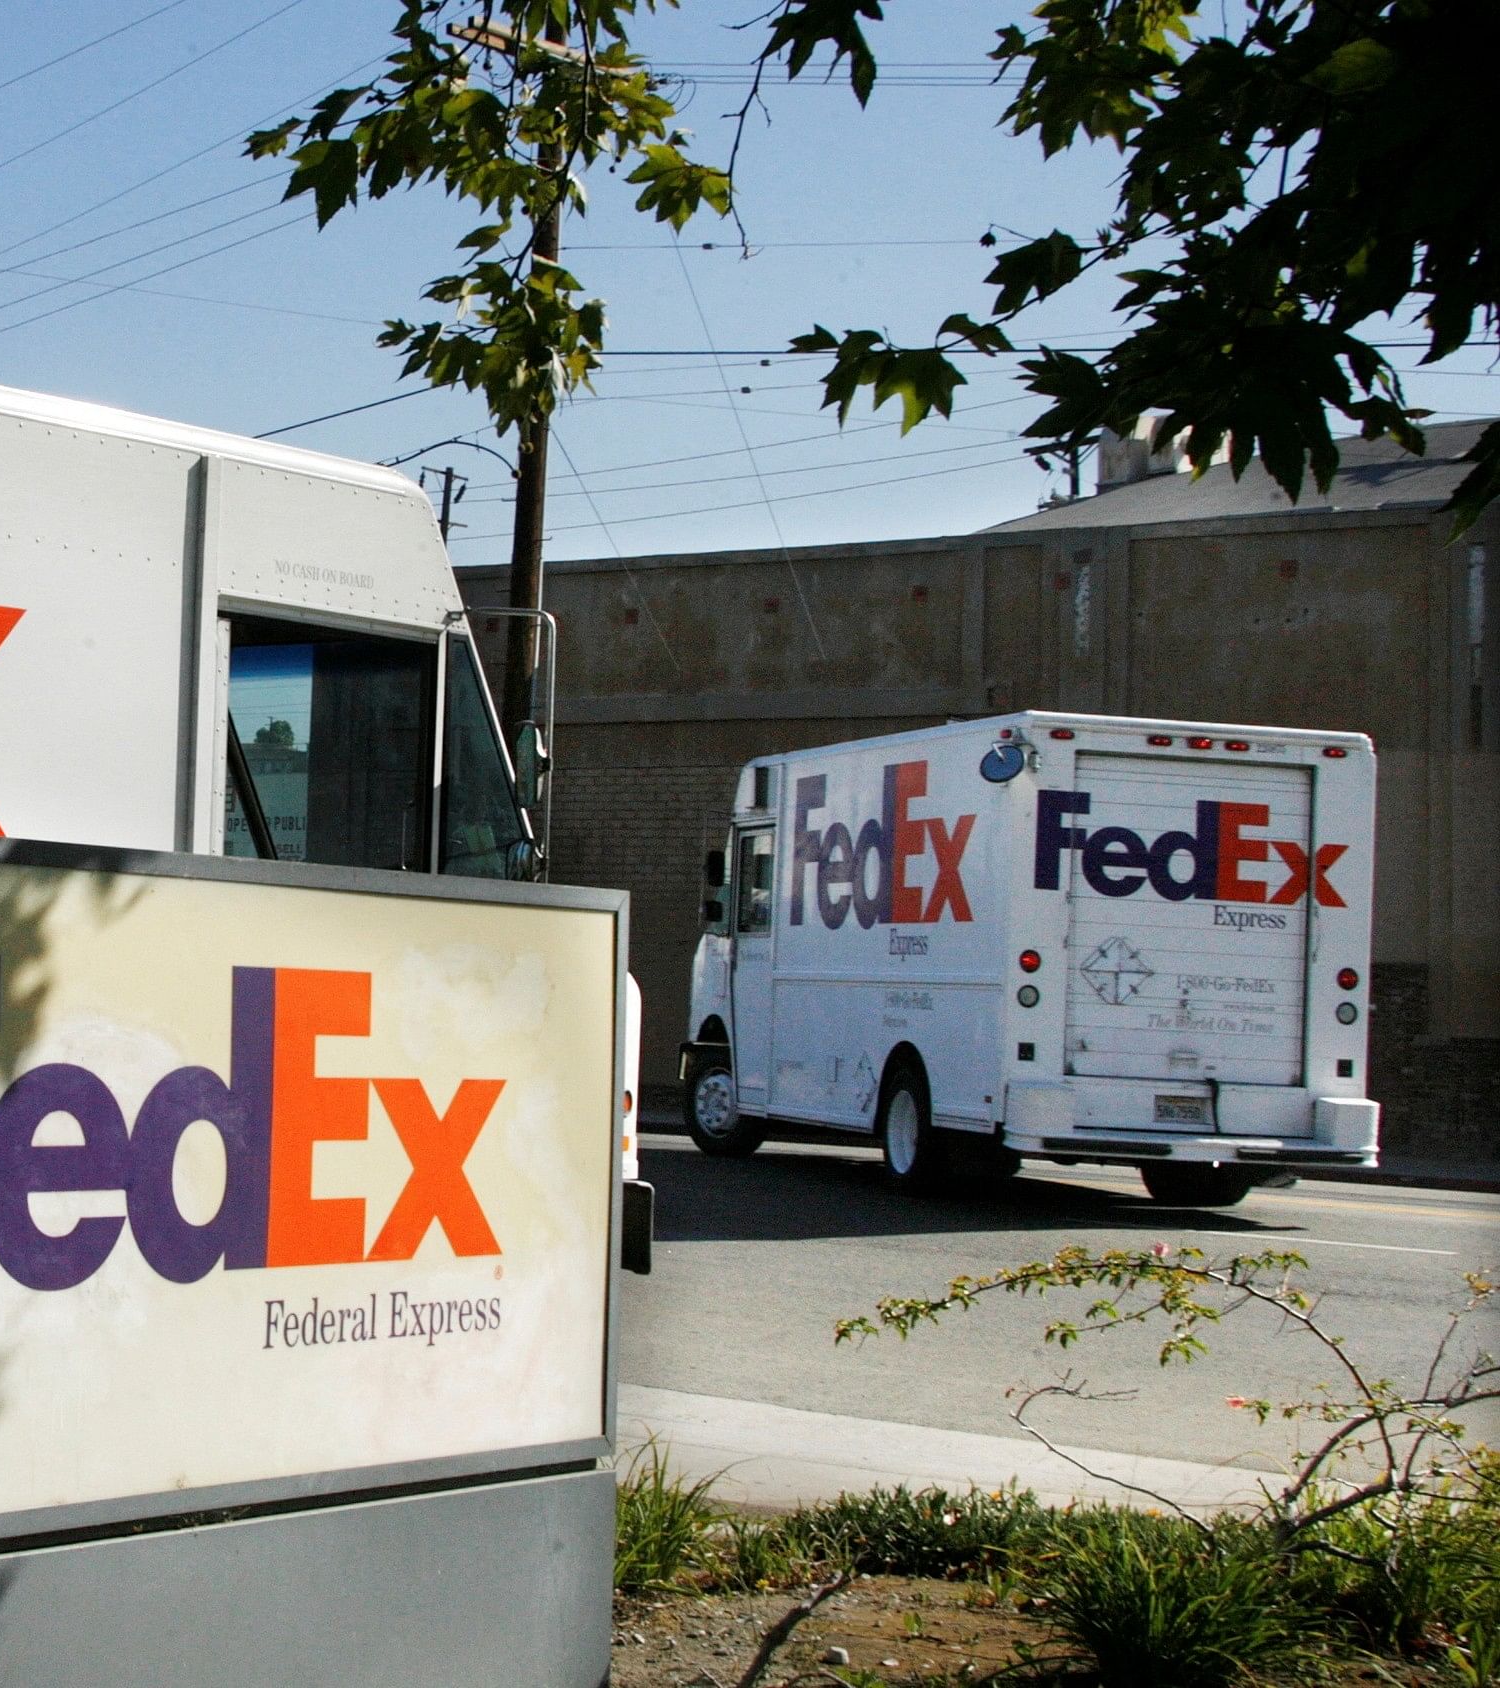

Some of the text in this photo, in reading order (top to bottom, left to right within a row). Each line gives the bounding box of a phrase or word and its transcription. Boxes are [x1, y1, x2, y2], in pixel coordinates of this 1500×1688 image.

[273, 559, 374, 589] NO CASH ON BOARD
[790, 760, 977, 930] FedEx
[1034, 790, 1348, 907] FedEx
[1213, 904, 1287, 932] Express
[263, 1288, 501, 1351] Federal Express
